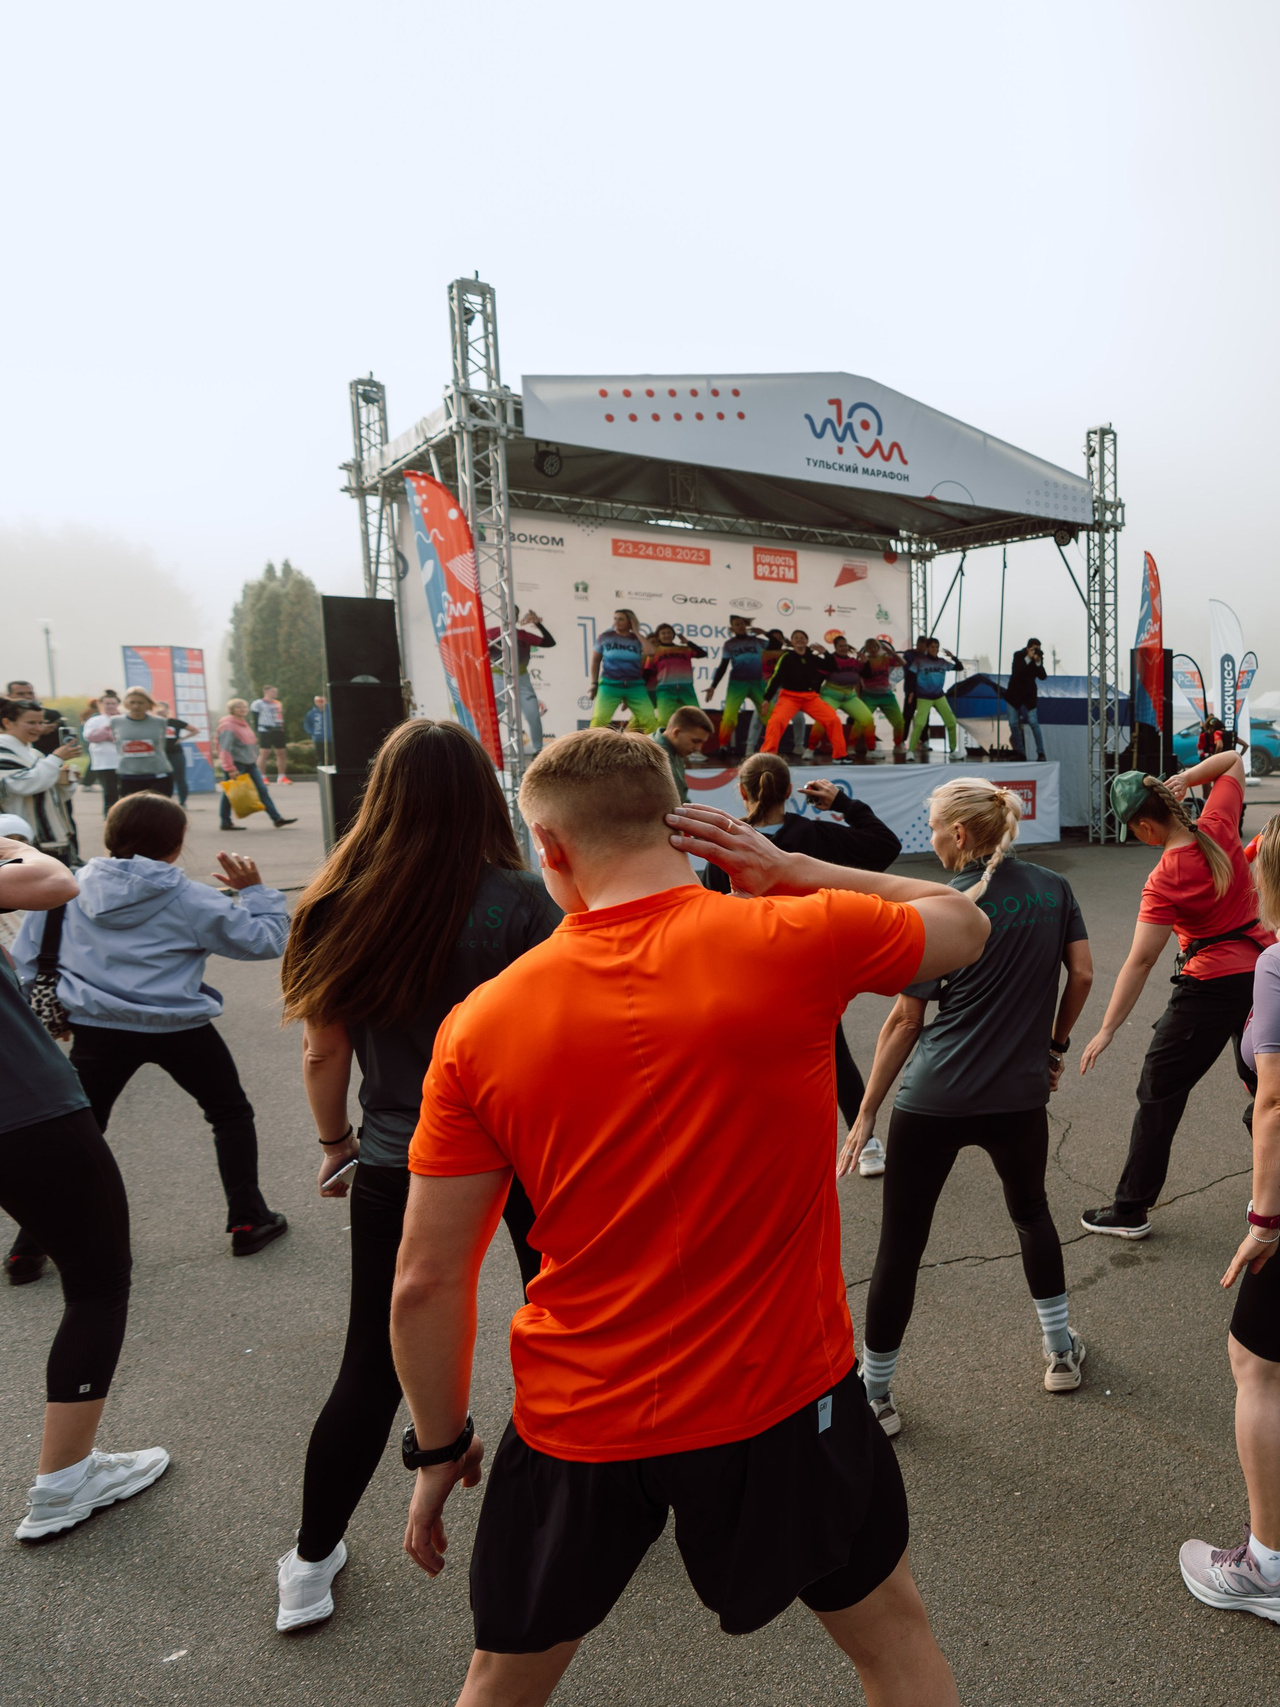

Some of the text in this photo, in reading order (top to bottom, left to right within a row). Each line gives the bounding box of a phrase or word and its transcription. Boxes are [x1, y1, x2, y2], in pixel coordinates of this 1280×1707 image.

[805, 456, 910, 482] ТУЛЬСКИЙ МАРАФОН
[508, 531, 564, 547] ВОКОМ
[617, 541, 706, 562] 23-24.08.2025
[756, 563, 795, 580] 89.2 FM
[689, 596, 718, 606] GAC
[979, 892, 1058, 919] OOMS
